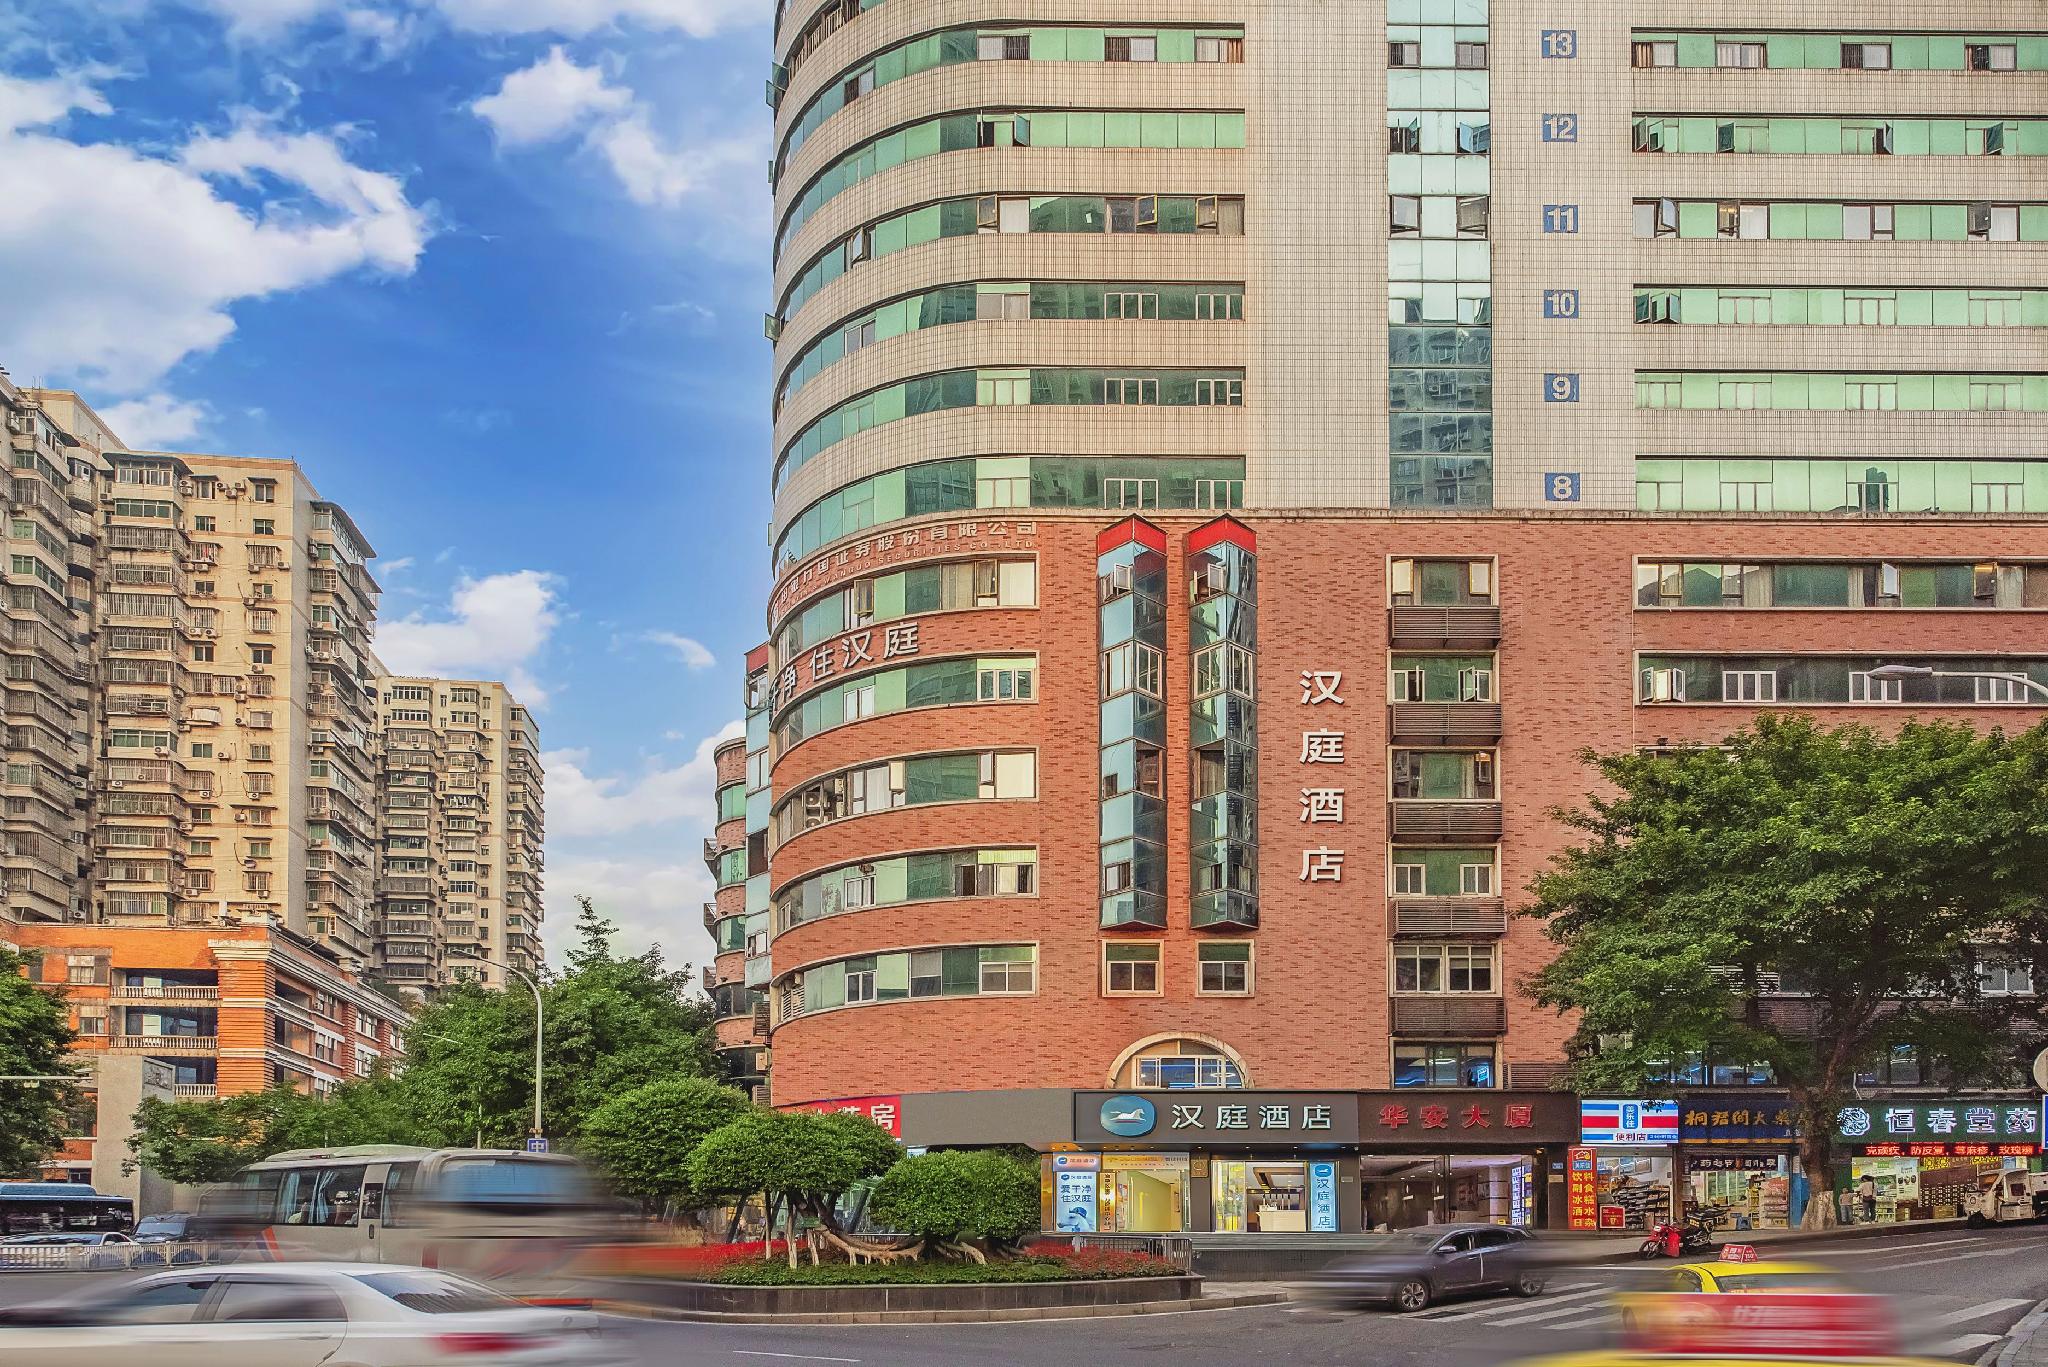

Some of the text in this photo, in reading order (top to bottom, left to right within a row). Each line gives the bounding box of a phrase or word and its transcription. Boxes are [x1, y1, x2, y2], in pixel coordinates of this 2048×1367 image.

[1543, 32, 1574, 57] 13
[1544, 116, 1574, 141] 12
[1547, 206, 1575, 232] 11
[1547, 292, 1575, 317] 10
[1552, 376, 1570, 400] 9
[1553, 475, 1572, 499] 8
[878, 544, 961, 564] SECURITIES
[1299, 669, 1345, 883] 汉庭酒店
[1171, 1104, 1332, 1131] 汉庭酒店
[1379, 1103, 1535, 1130] 华安大厦
[1885, 1107, 2038, 1134] 恒春堂药
[1615, 1132, 1647, 1142] 便利店
[1061, 1184, 1092, 1194] 爱干净
[1572, 1172, 1595, 1182] 饮料
[1572, 1183, 1595, 1194] 副食
[1061, 1194, 1093, 1203] 住汉庭
[1316, 1178, 1331, 1226] 汉庭酒店
[1572, 1195, 1595, 1206] 冰糕
[1572, 1207, 1595, 1217] 酒水
[1573, 1218, 1595, 1228] 日杂
